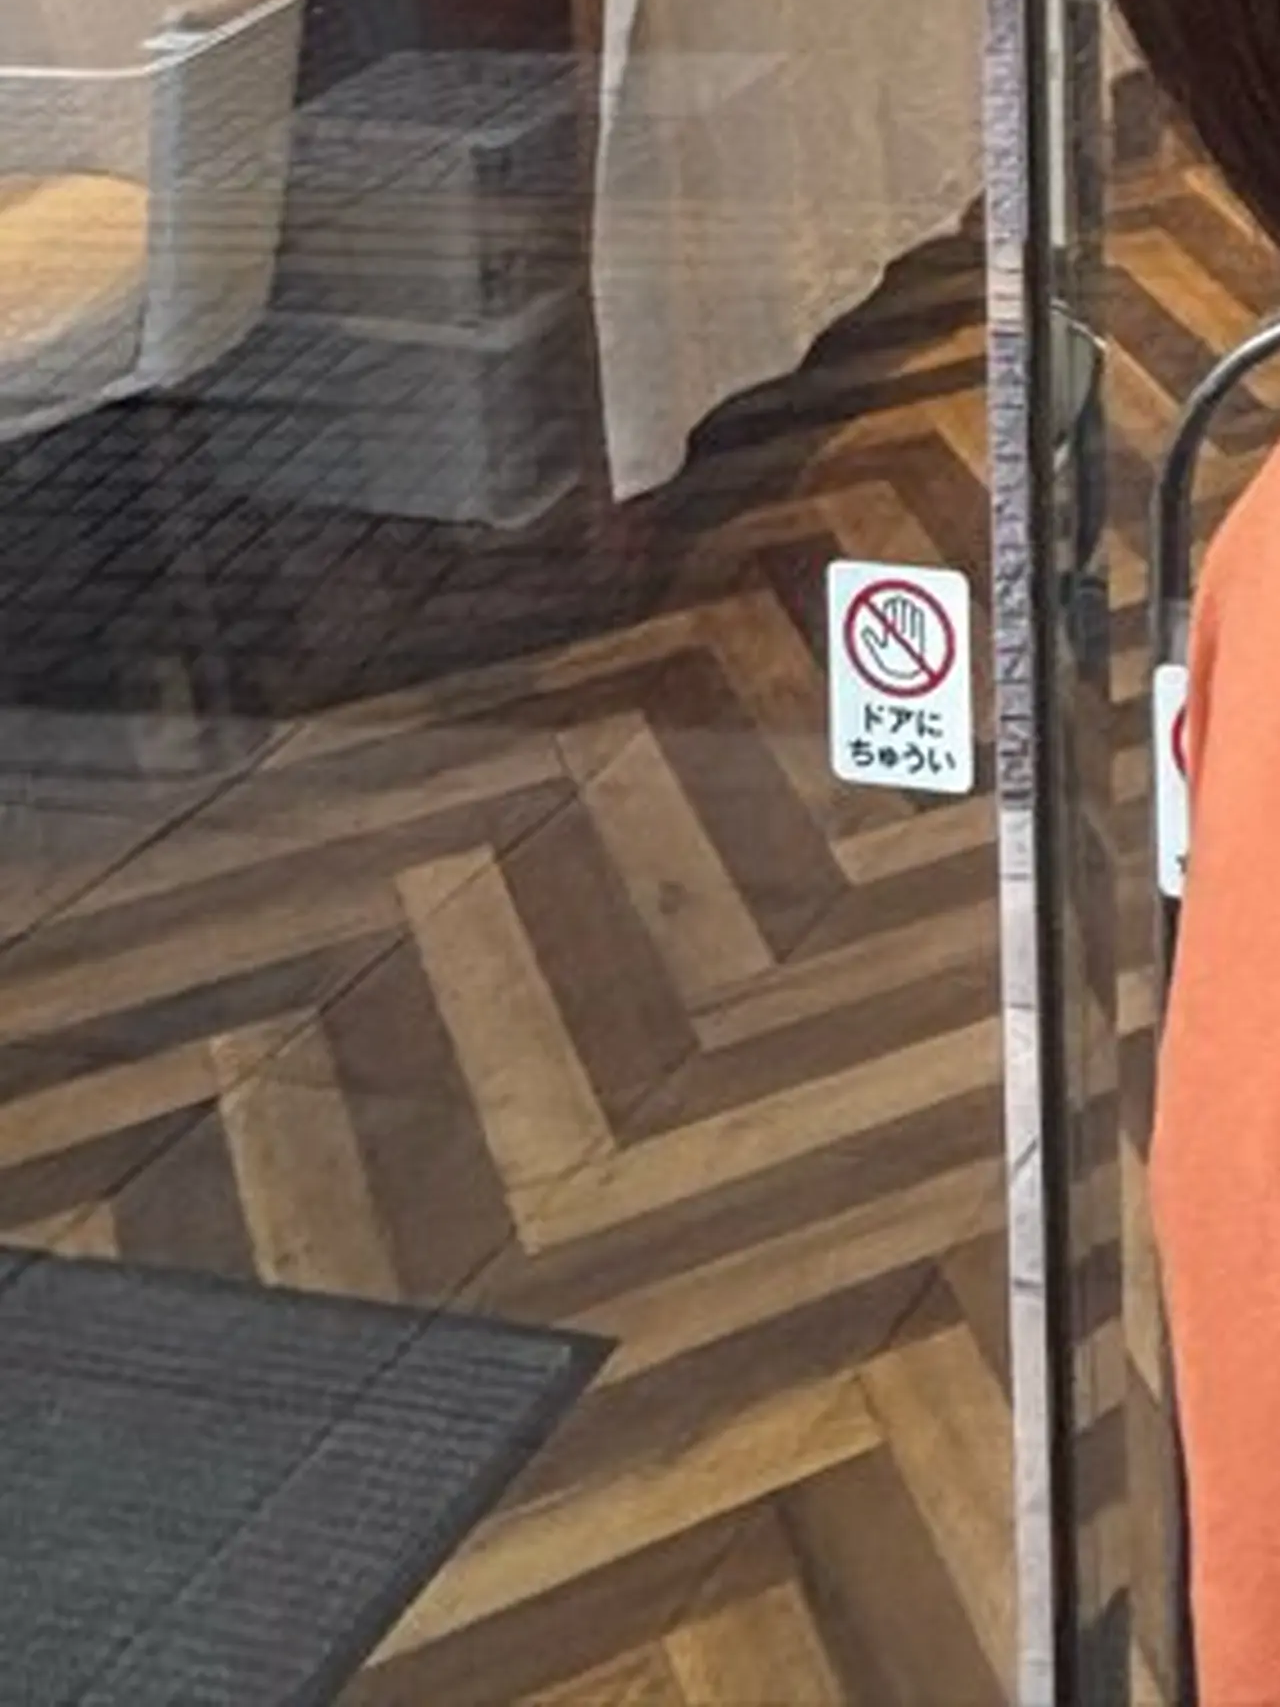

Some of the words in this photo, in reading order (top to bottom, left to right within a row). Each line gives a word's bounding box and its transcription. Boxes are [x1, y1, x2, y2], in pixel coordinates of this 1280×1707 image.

[863, 703, 944, 738] ドアに
[848, 739, 957, 775] ちゅうい
